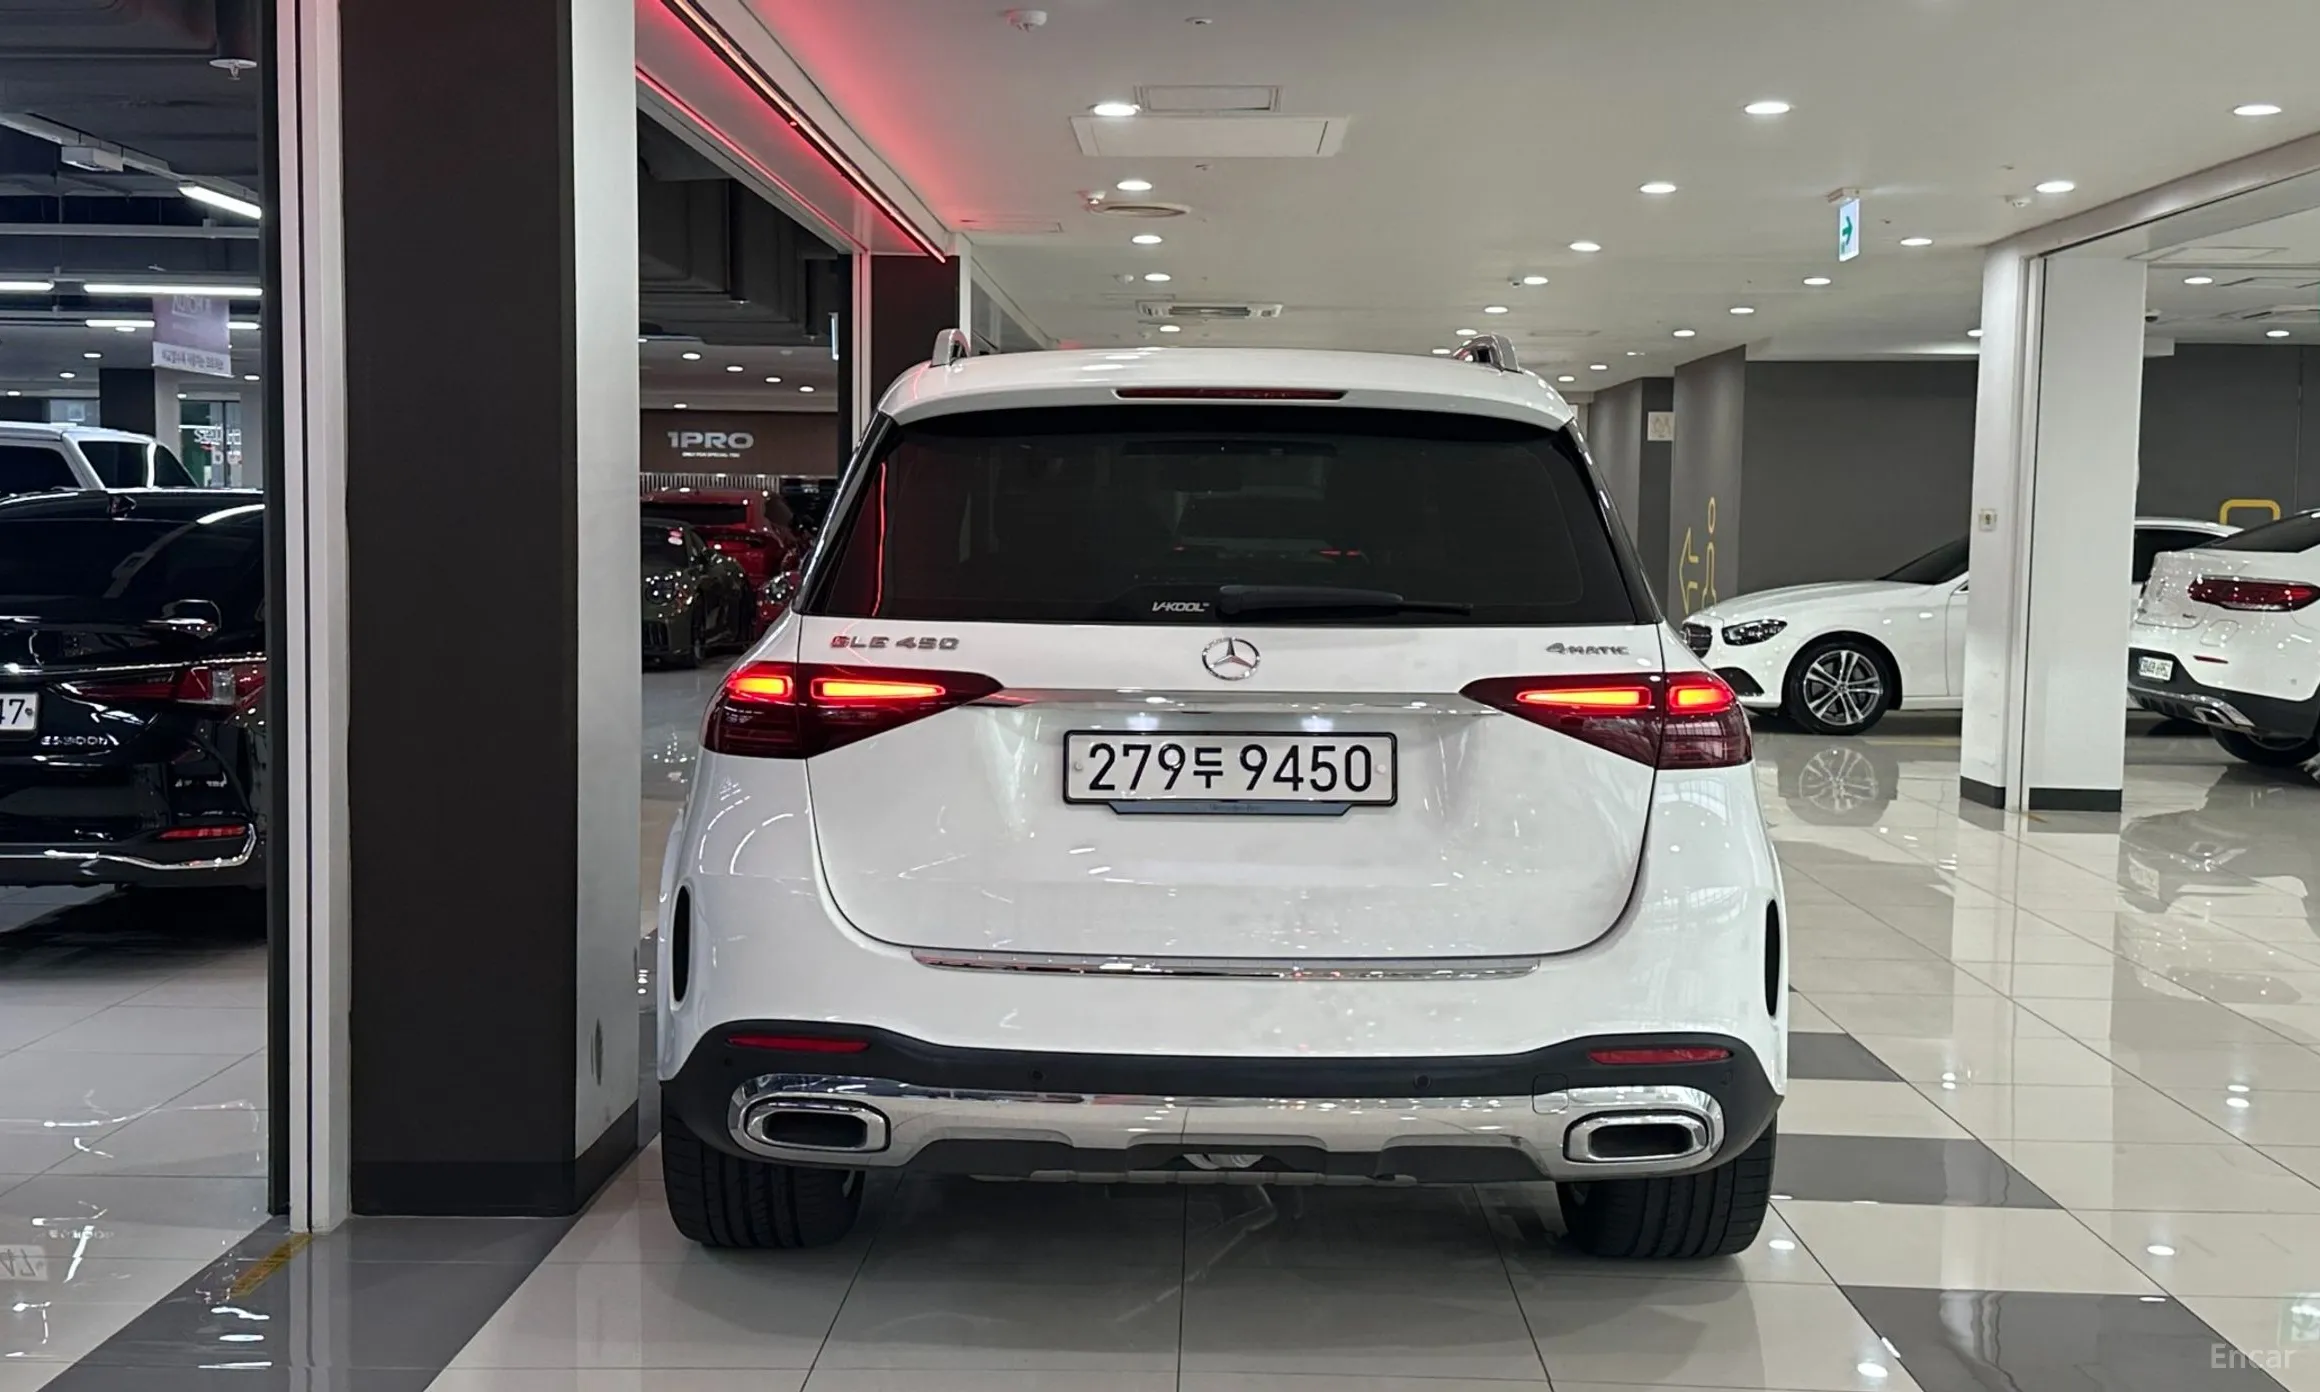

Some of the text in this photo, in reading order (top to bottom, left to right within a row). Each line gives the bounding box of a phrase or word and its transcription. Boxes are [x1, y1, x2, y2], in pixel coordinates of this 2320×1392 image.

[667, 432, 754, 449] 1PRO
[830, 636, 959, 650] GLE 450
[0, 699, 25, 725] 7
[1089, 743, 1372, 792] 279두 9450
